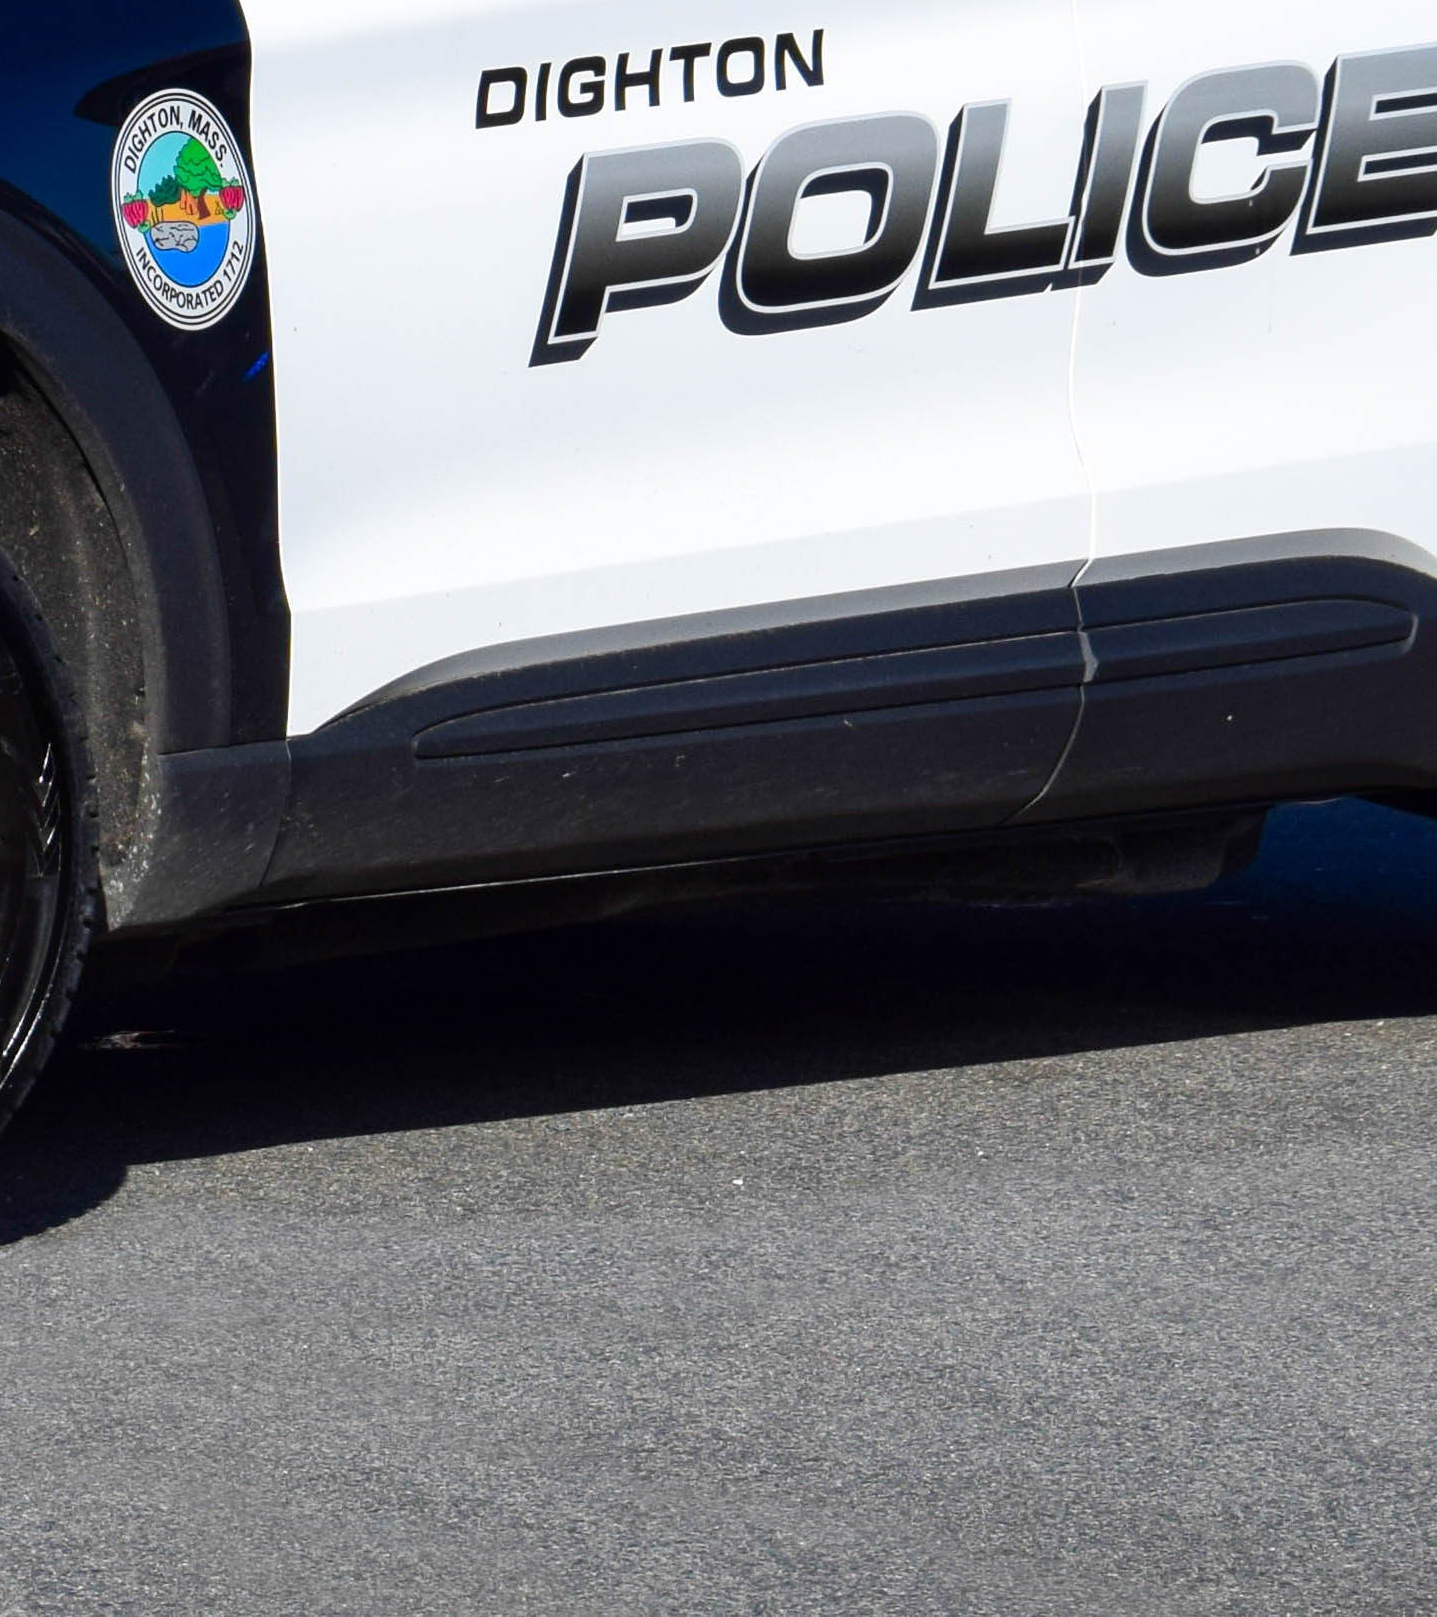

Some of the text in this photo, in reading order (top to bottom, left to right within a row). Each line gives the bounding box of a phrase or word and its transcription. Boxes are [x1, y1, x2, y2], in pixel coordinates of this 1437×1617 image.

[476, 29, 824, 129] DIGHTON
[123, 105, 228, 174] DIGHTON, MASS.
[135, 239, 244, 311] INCORPORATED 1712
